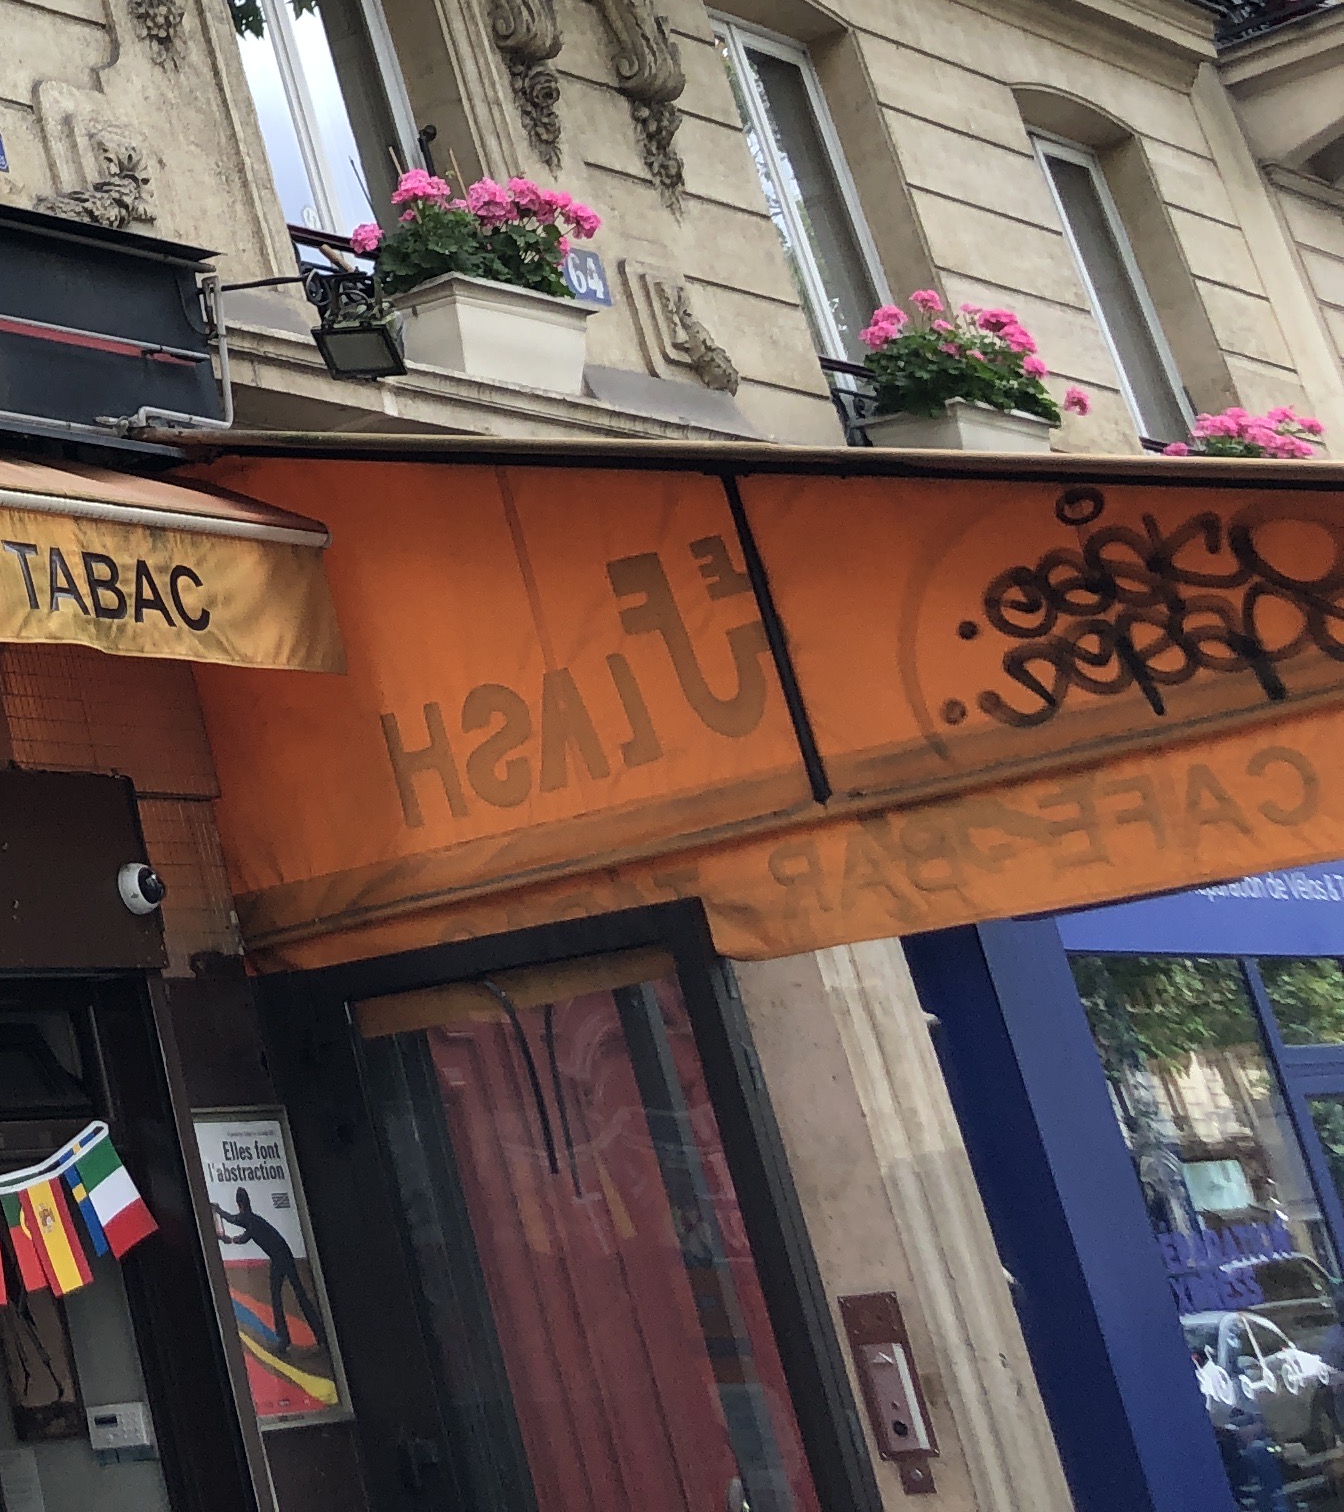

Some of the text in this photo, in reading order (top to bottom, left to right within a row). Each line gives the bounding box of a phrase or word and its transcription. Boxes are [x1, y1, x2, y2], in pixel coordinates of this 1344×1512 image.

[567, 252, 605, 299] 64
[0, 539, 212, 634] TABAC
[222, 1139, 281, 1162] Elles font
[208, 1161, 285, 1183] l'abstraction
